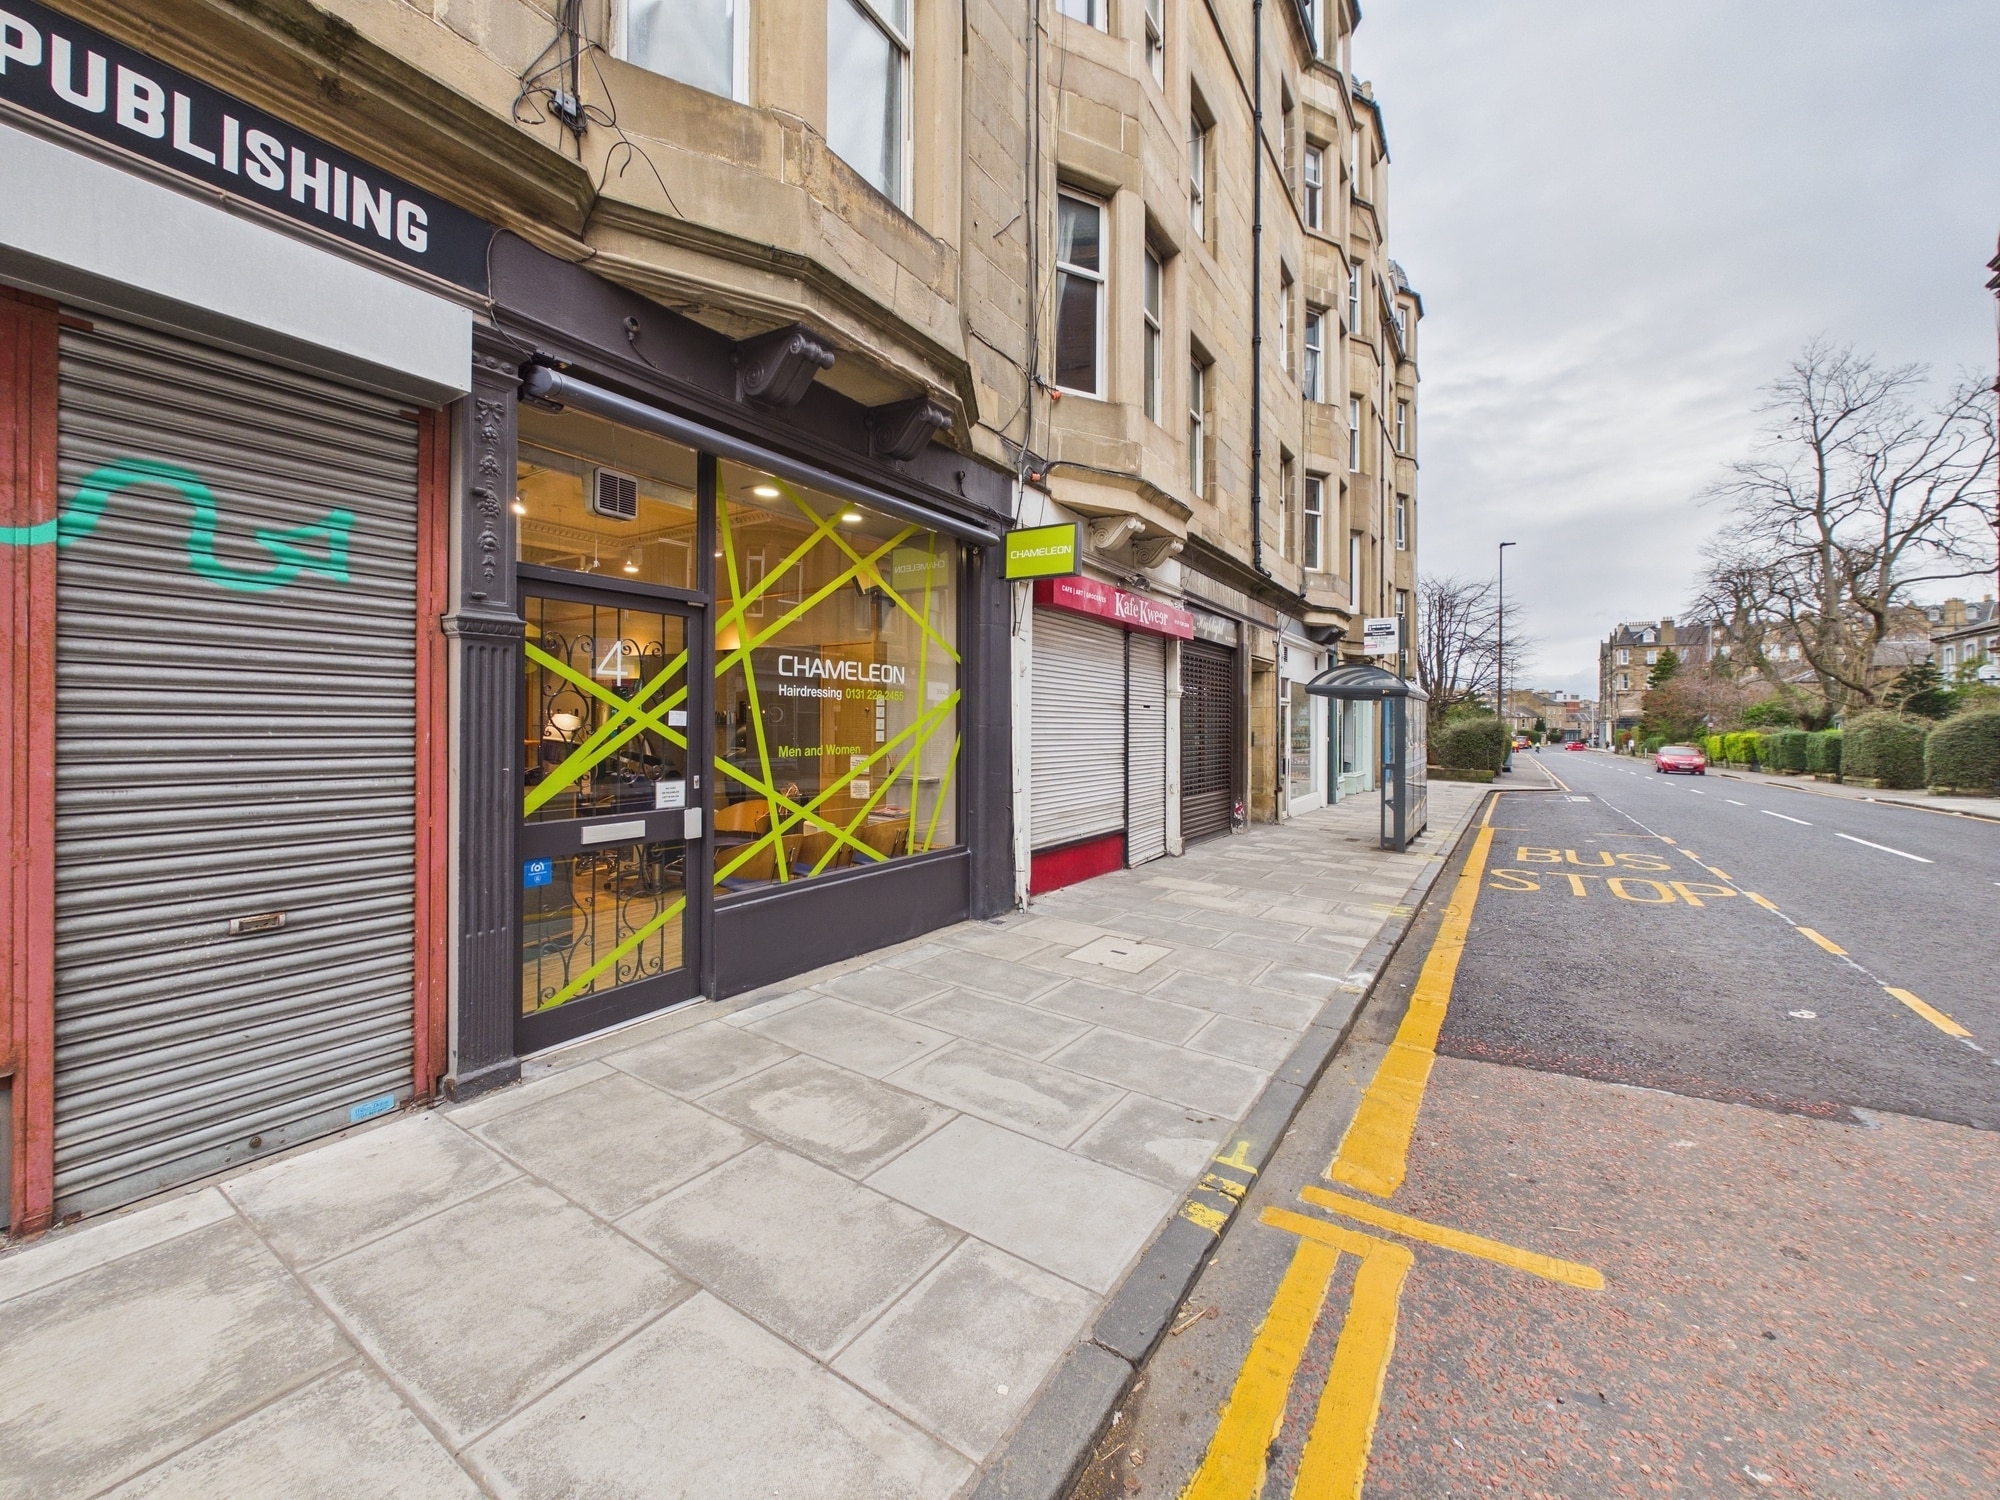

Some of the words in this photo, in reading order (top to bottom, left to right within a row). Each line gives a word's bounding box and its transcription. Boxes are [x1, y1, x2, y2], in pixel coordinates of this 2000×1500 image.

[0, 9, 428, 253] PUBLISHING
[1010, 545, 1072, 559] CHAMELEON
[1061, 584, 1073, 594] CAFE
[1115, 591, 1139, 618] Kafe
[596, 640, 628, 687] 4
[778, 655, 905, 685] CHAMELEON
[778, 684, 842, 701] Hairdressing
[845, 688, 865, 700] 0131
[885, 690, 904, 701] 2455
[778, 745, 802, 758] Men
[804, 745, 823, 757] and
[826, 744, 861, 756] Women
[1516, 846, 1671, 871] BUS
[1488, 868, 1738, 907] STOP
